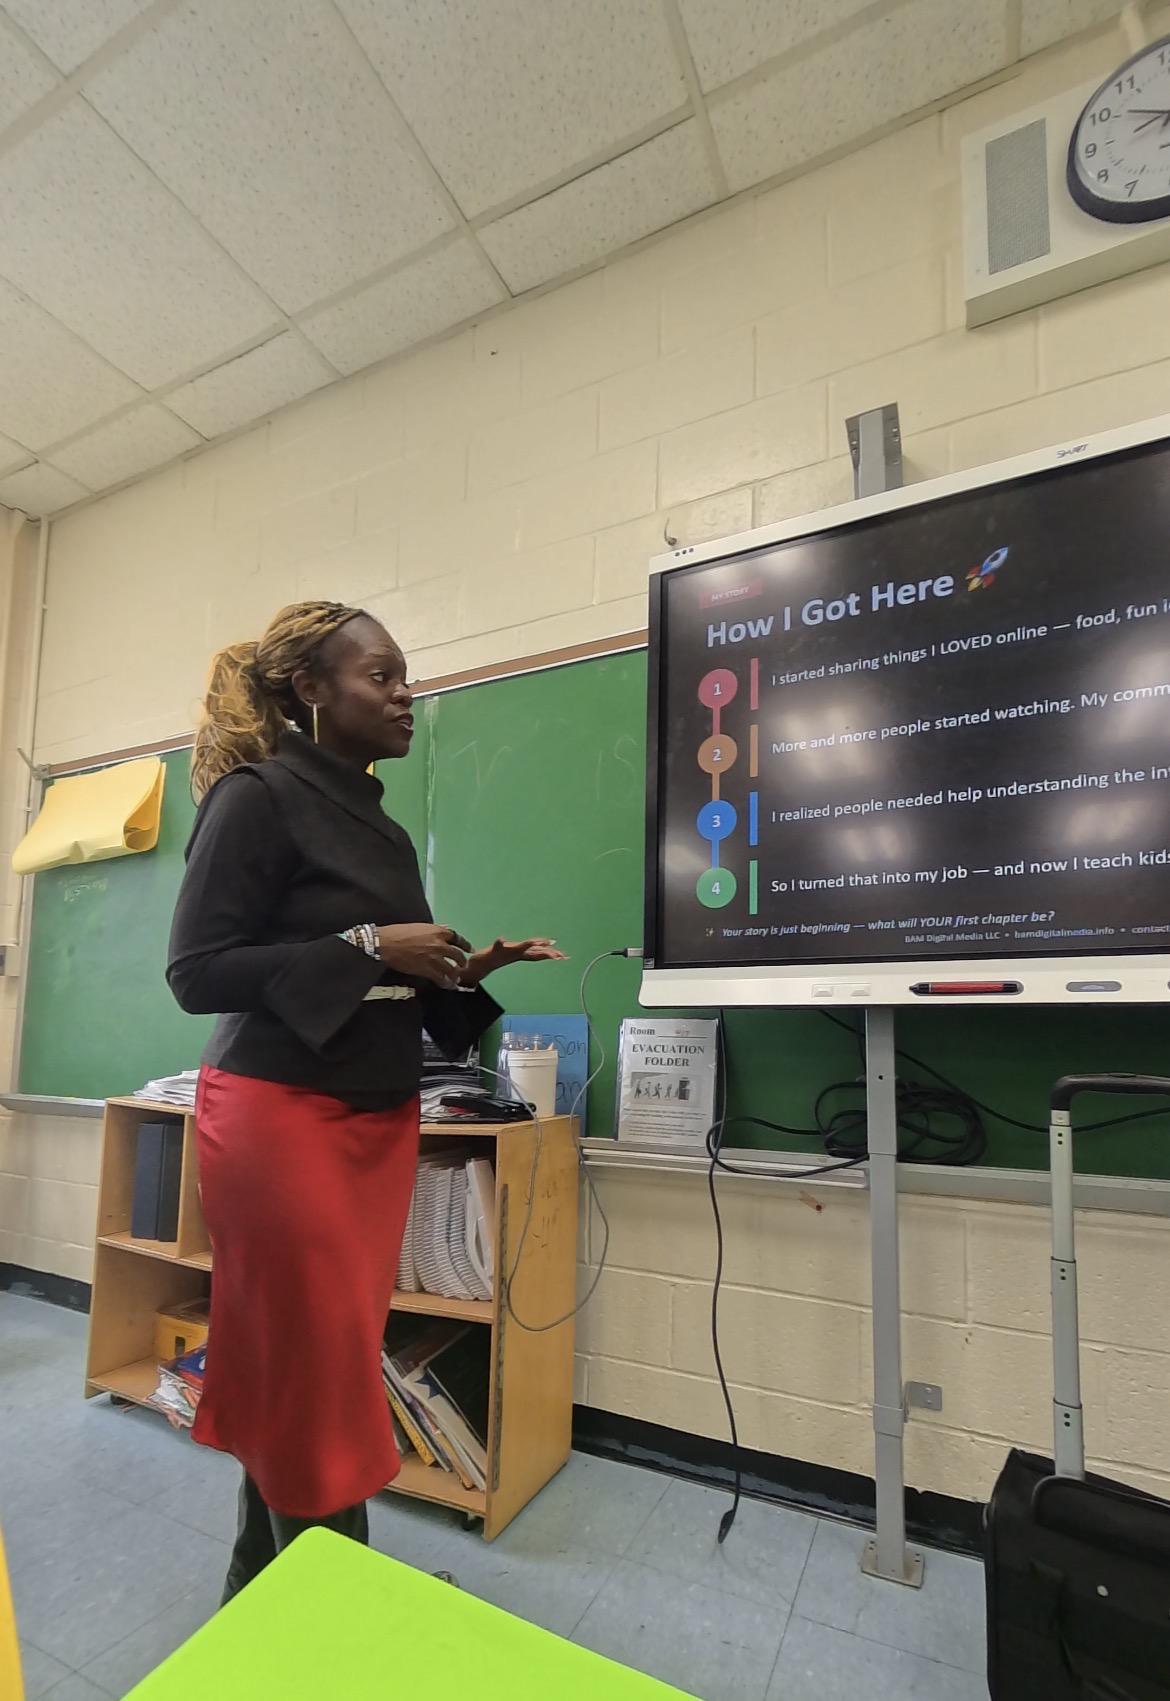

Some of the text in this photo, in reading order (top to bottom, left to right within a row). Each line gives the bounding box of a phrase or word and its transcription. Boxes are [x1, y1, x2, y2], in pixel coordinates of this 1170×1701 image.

[1114, 74, 1136, 95] 11
[1089, 107, 1112, 127] 10
[1084, 143, 1097, 158] 9
[1097, 168, 1109, 184] 8
[1124, 179, 1139, 198] 7
[707, 574, 955, 648] How I Got Here
[779, 665, 825, 684] started
[828, 656, 879, 677] sharing
[883, 646, 927, 666] things
[940, 633, 993, 655] LOVED
[996, 625, 1048, 645] online
[1076, 608, 1121, 630] food,
[1126, 603, 1158, 620] fun
[713, 683, 722, 696] 1
[772, 741, 807, 755] More
[810, 734, 835, 749] and
[840, 729, 877, 744] more
[881, 719, 931, 740] people
[935, 709, 990, 730] started
[994, 698, 1076, 720] watching.
[1080, 692, 1109, 708] My
[712, 749, 722, 761] 2
[779, 805, 830, 823] realized
[834, 799, 883, 819] people
[887, 790, 943, 810] needed
[948, 786, 982, 803] help
[987, 774, 1109, 799] understanding
[1114, 768, 1145, 784] the
[712, 815, 721, 828] 3
[771, 880, 788, 893] So
[799, 874, 844, 890] turned
[848, 873, 879, 887] that
[882, 871, 911, 884] into
[915, 870, 938, 884] my
[941, 865, 968, 883] job
[994, 860, 1024, 877] and
[1030, 861, 1068, 875] now
[1083, 852, 1133, 870] teach
[711, 881, 721, 895] 4
[722, 928, 743, 937] Your
[744, 927, 768, 938] story
[771, 926, 778, 935] is
[779, 925, 799, 936] just
[800, 922, 851, 935] beginning
[868, 919, 897, 931] what
[898, 917, 918, 929] will
[920, 915, 954, 928] YOUR
[953, 915, 979, 928] first
[981, 912, 1028, 927] chapter
[1031, 910, 1056, 922] be?
[926, 932, 954, 943] Digital
[955, 931, 984, 941] Media
[985, 931, 1001, 940] LLC
[1014, 926, 1115, 940] bamdigitalmedia.info
[630, 1026, 655, 1036] Room
[632, 1043, 706, 1055] EVACUATION
[644, 1056, 690, 1067] FOLDER
